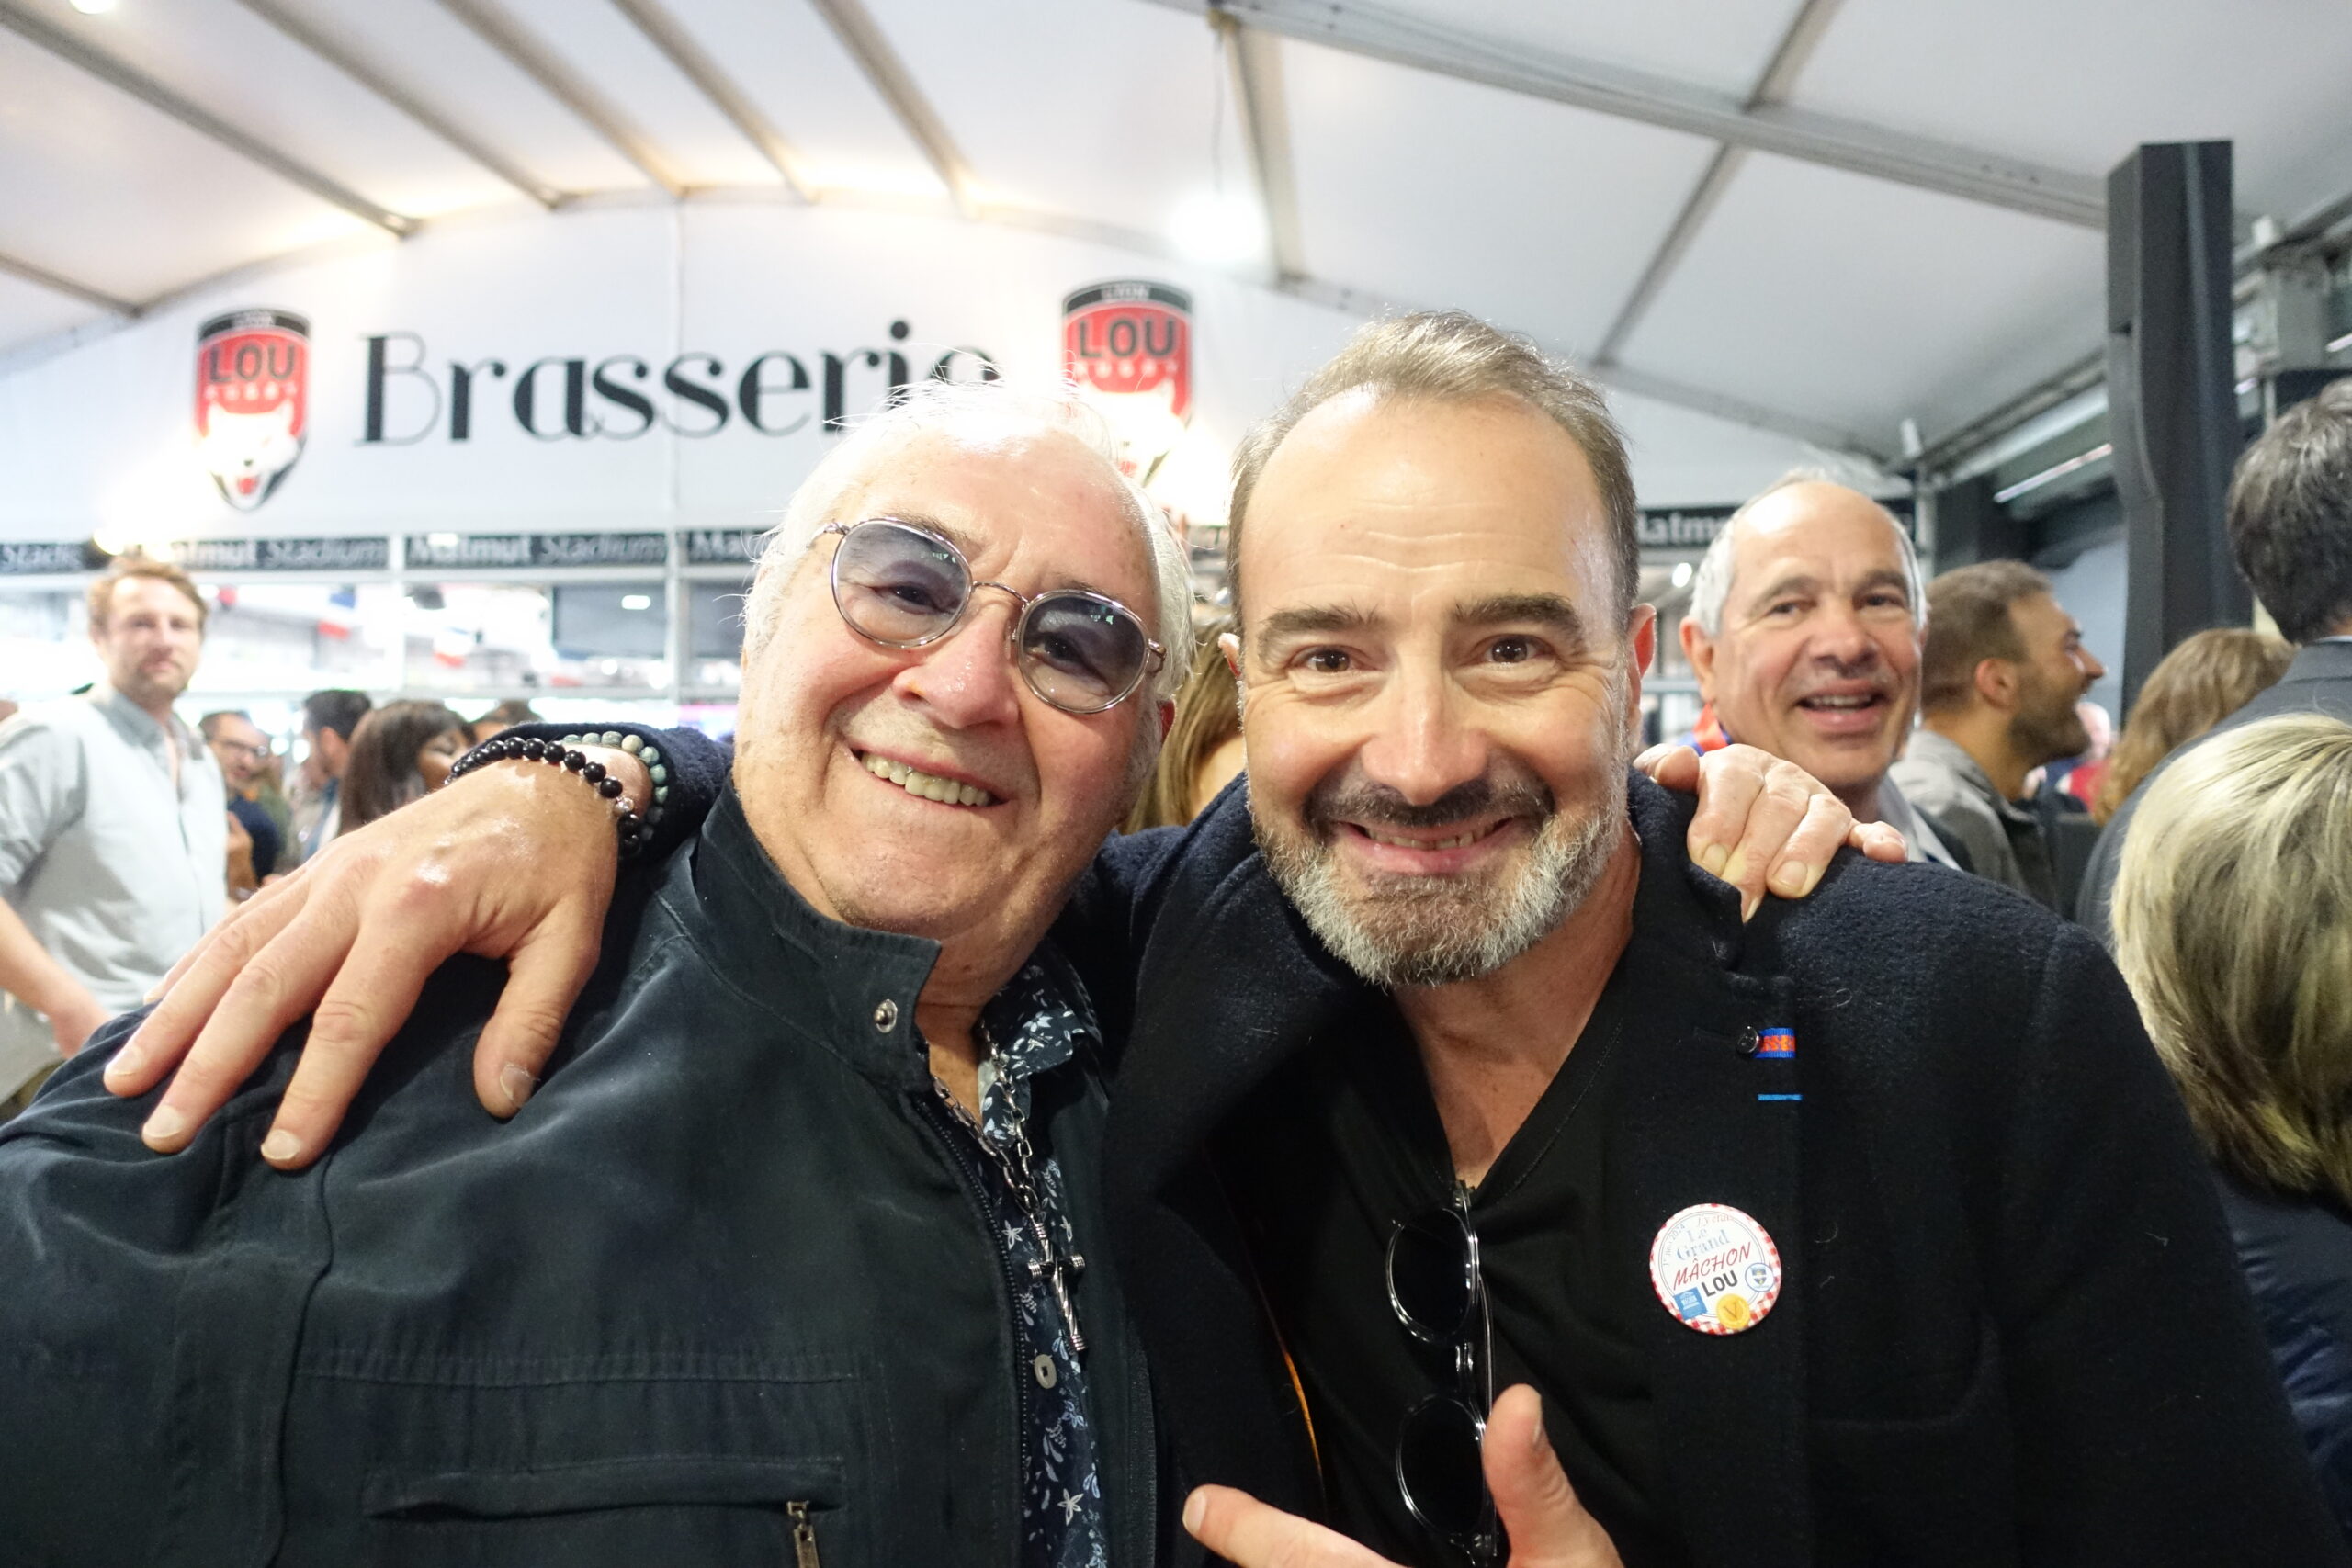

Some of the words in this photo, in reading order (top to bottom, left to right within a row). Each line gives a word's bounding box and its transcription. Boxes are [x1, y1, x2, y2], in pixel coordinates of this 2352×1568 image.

[1078, 318, 1175, 357] LOU
[209, 341, 296, 383] LOU
[1677, 1229, 1730, 1261] Grand
[1673, 1242, 1751, 1291] MÂCHON
[1702, 1269, 1738, 1297] LOU
